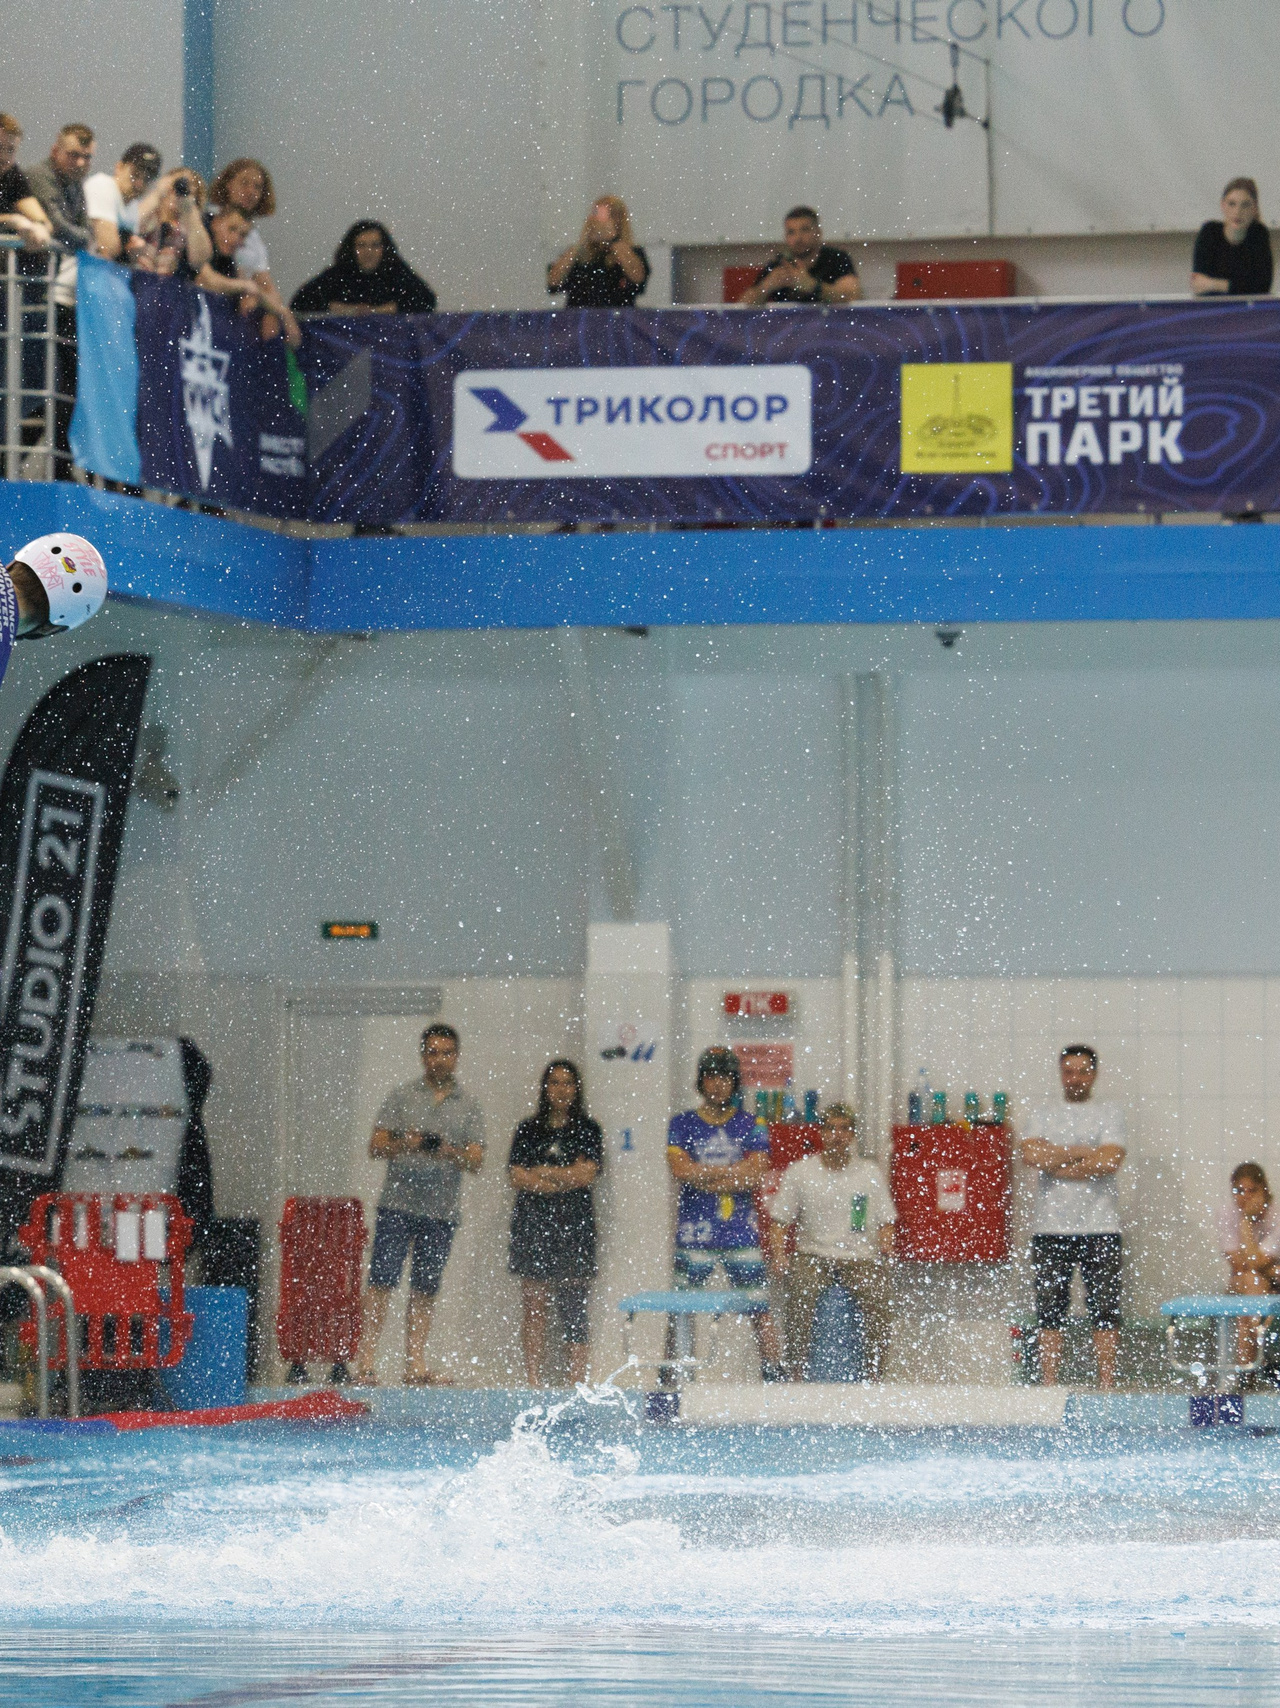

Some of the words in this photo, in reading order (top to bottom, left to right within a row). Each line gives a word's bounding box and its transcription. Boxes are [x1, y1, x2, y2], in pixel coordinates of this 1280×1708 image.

[615, 0, 1166, 58] СТУДЕНЧЕСКОГО
[615, 73, 916, 131] ГОРОДКА
[546, 394, 789, 426] ТРИКОЛОР
[1023, 377, 1185, 419] ТРЕТИЙ
[704, 441, 789, 461] СПОРТ
[1024, 420, 1185, 467] ПАРК
[0, 893, 72, 1138] STUDIO
[37, 806, 84, 876] 21
